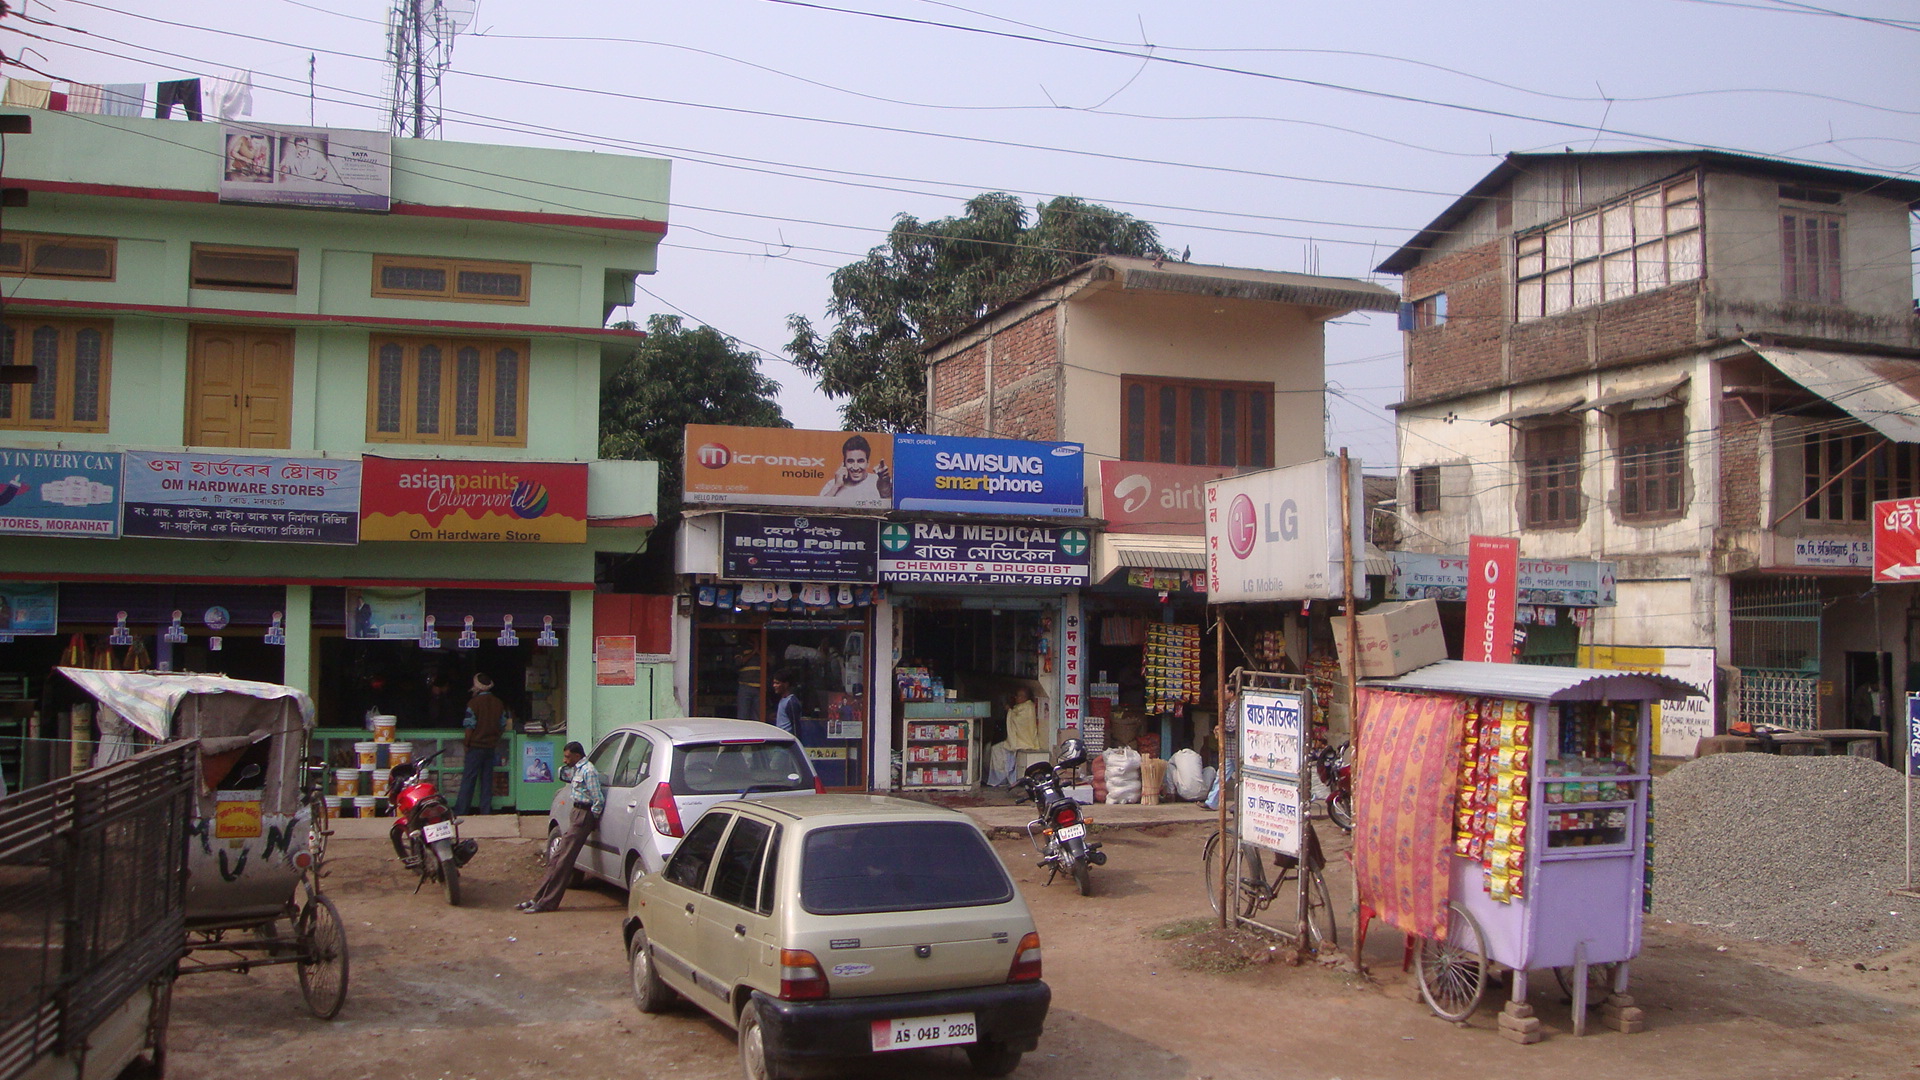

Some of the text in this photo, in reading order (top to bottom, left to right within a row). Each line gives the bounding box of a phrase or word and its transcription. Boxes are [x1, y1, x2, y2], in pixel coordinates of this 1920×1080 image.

[15, 453, 30, 466] IN
[34, 453, 81, 468] EVERY
[84, 455, 114, 470] CAN
[935, 452, 1043, 475] SAMSUNG
[399, 468, 519, 493] asianpaints
[781, 468, 825, 479] mobile
[162, 479, 325, 496] OM HARDWARE STORES
[935, 475, 1043, 494] smartphone
[427, 484, 528, 512] Colourworld
[1160, 482, 1205, 510] airt
[46, 520, 109, 531] MORANHAT
[1264, 498, 1298, 543] LG
[410, 529, 541, 541] Om Hardware Store
[914, 523, 1056, 543] RAJ MEDICAL
[735, 536, 866, 551] Hello Point
[967, 543, 1056, 562] মেডিকেল
[896, 561, 1072, 574] CHEMIST & DRUGGIST
[884, 572, 1082, 585] MORANHAT, PIN-785670
[1243, 578, 1283, 592] LG Mobile
[1483, 588, 1496, 663] odafone
[895, 1023, 975, 1043] AS 04B 2326
